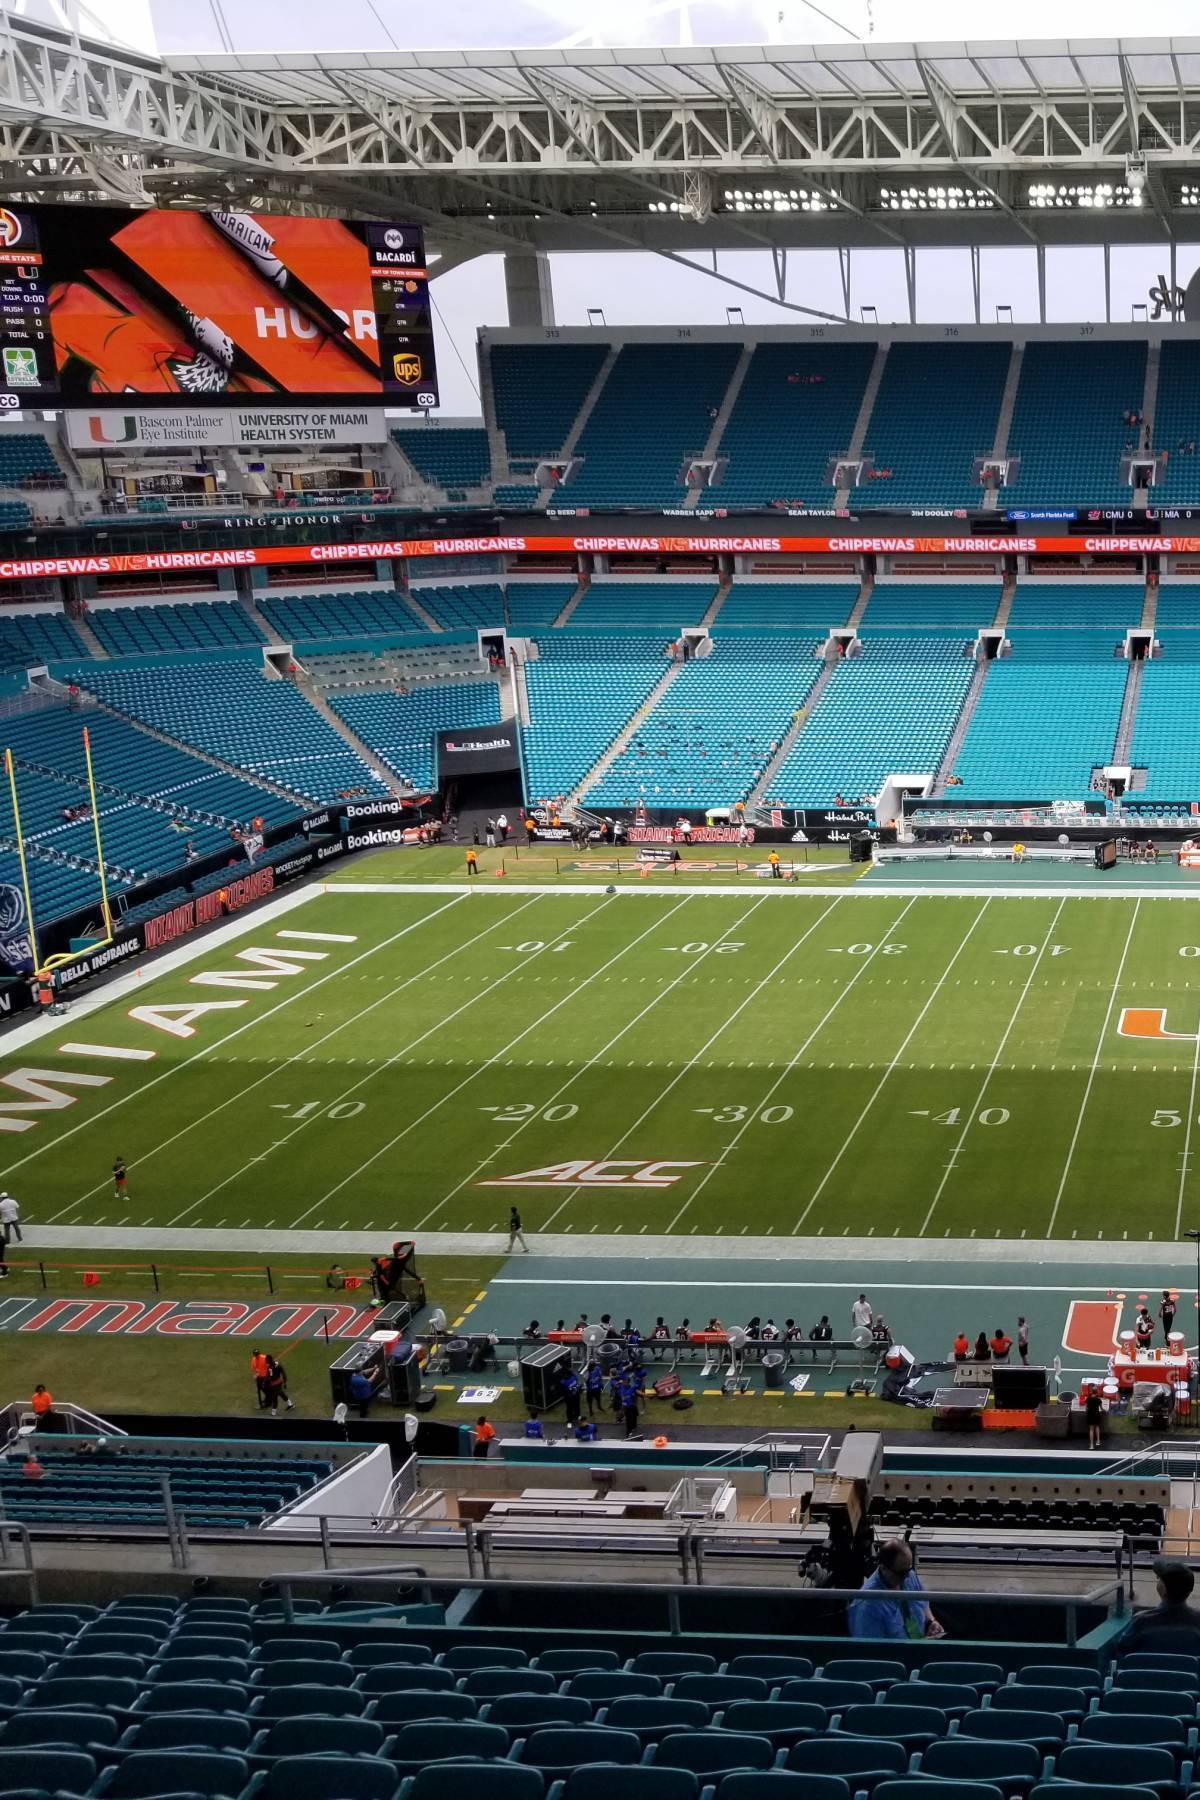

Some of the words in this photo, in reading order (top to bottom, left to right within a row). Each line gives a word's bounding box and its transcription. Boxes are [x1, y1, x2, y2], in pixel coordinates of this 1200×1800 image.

[375, 251, 416, 263] BACARDÍ
[23, 295, 45, 303] 0:00
[3, 306, 24, 314] RUSH
[944, 328, 959, 337] 316
[396, 362, 420, 381] ups
[419, 395, 434, 404] CC
[139, 415, 183, 428] Bascom
[185, 414, 223, 427] Palmer
[238, 414, 309, 426] UNIVERSITY
[311, 414, 327, 425] OF
[329, 414, 368, 425] MIAMI
[141, 429, 161, 443] Eye
[163, 428, 208, 440] Institute
[241, 429, 287, 441] HEALTH
[289, 428, 336, 440] SYSTEM
[925, 509, 953, 517] DOOLEY
[1105, 511, 1124, 519] CMU
[1127, 511, 1133, 519] 0
[1164, 511, 1179, 519] MIA
[224, 517, 267, 528] RING
[282, 515, 341, 526] HONOR
[310, 543, 403, 560] CHIPPEWAS
[434, 537, 526, 553] HURRICANES
[573, 537, 660, 551] CHIPPEWAS
[688, 537, 780, 551] HURRICANES
[829, 538, 915, 551] CHIPPEWAS
[944, 538, 1036, 551] HURRICANES
[1085, 537, 1172, 550] CHIPPEWAS
[0, 556, 110, 577] CHIPPEWAS
[147, 550, 256, 568] HURRICANES
[628, 827, 675, 842] MIAMI
[144, 901, 194, 950] MIAMI
[491, 1103, 580, 1122] 20
[712, 1104, 794, 1124] 30
[931, 1106, 1011, 1126] 40
[475, 1159, 711, 1187] ACC
